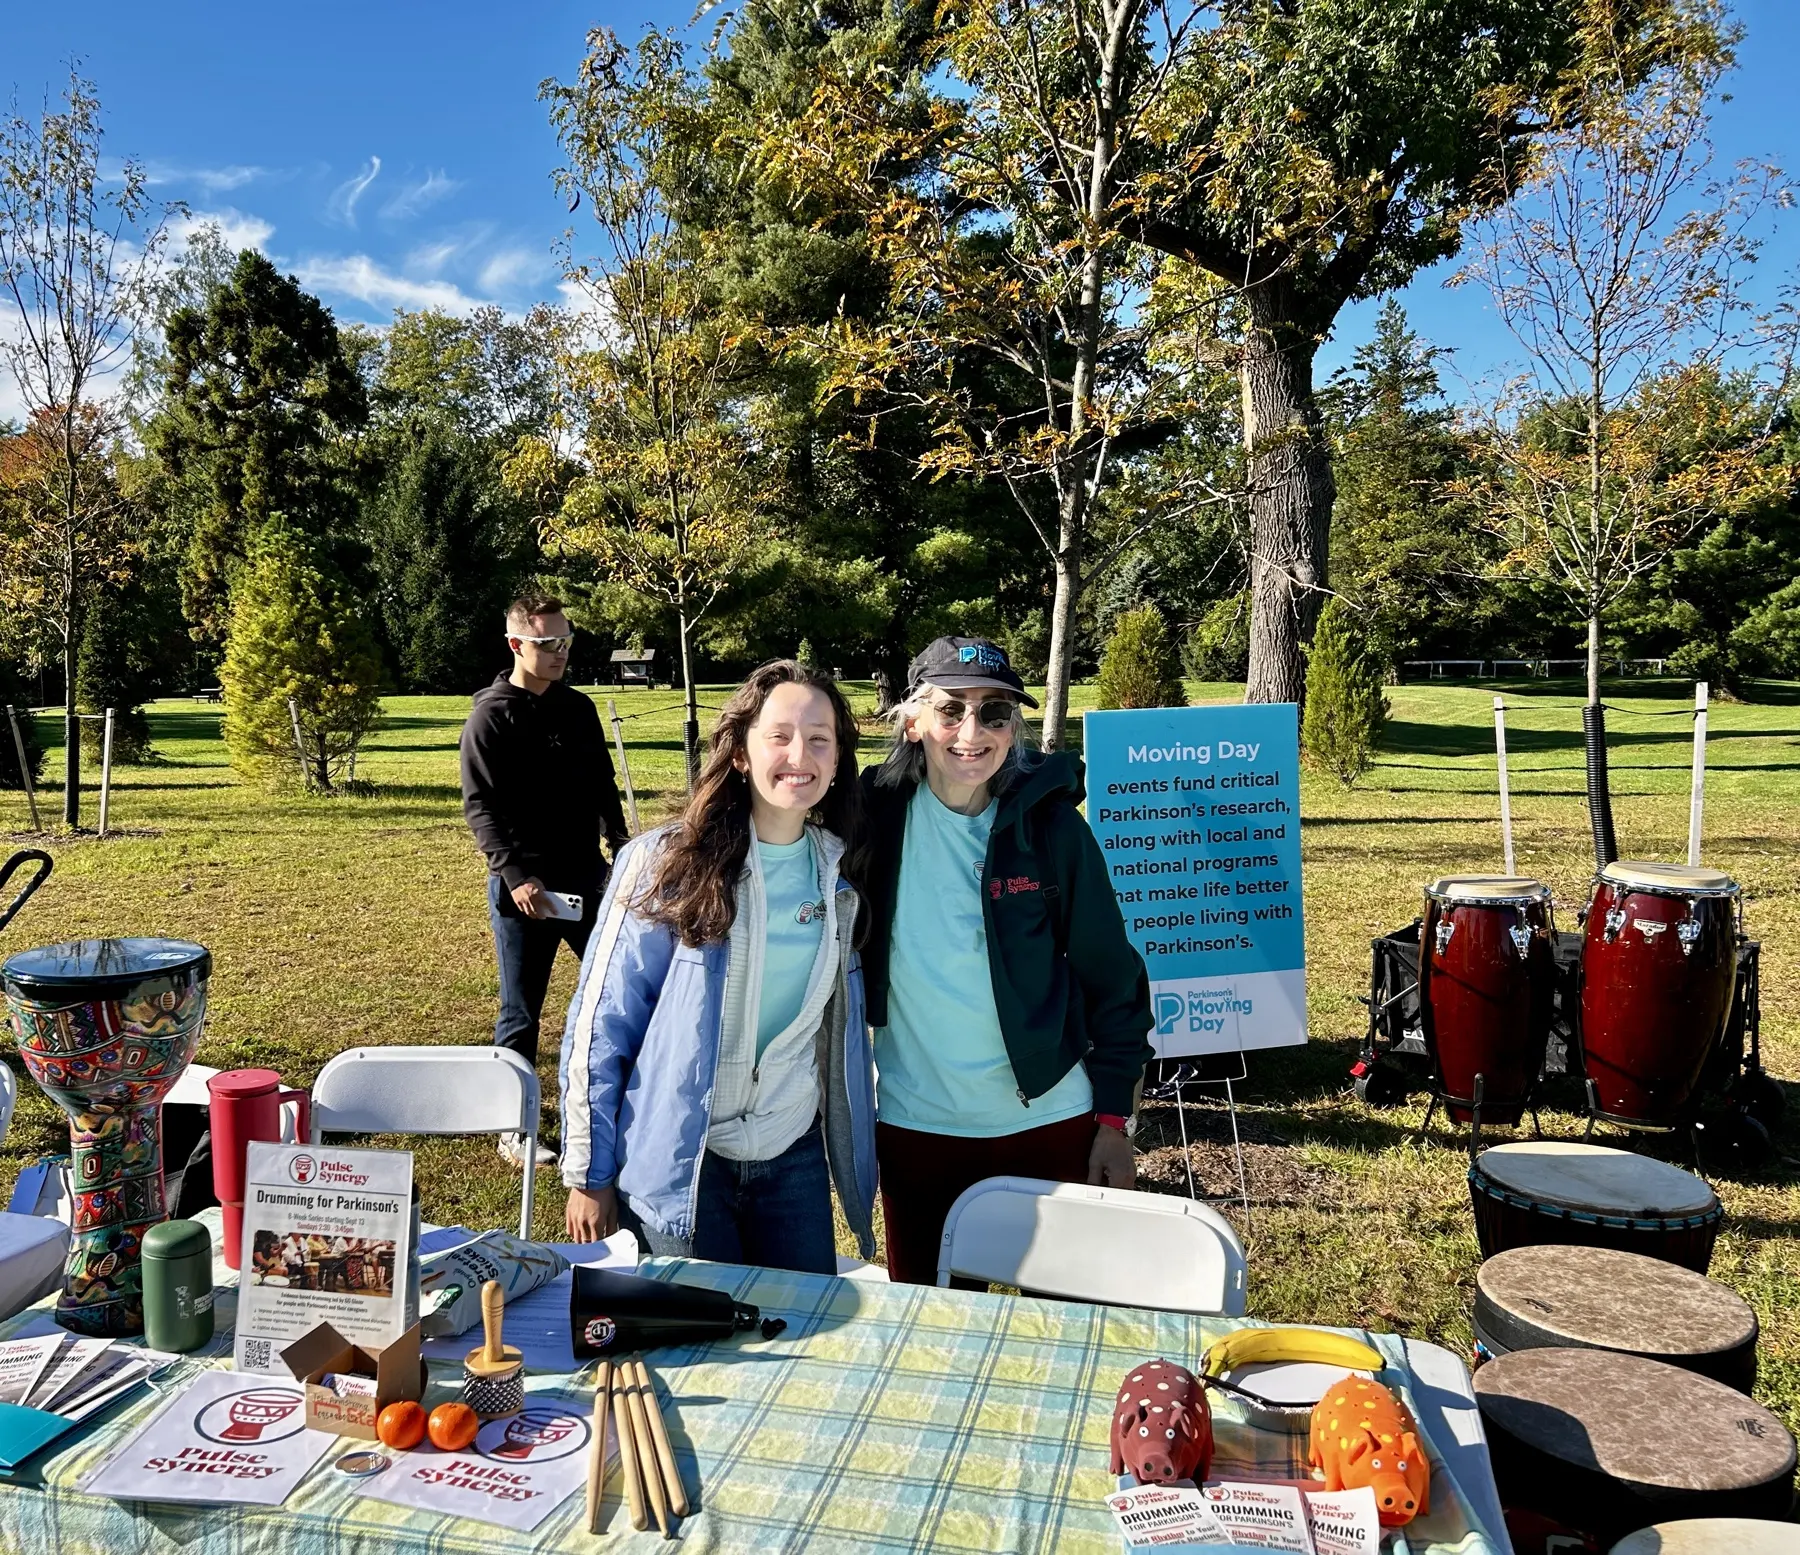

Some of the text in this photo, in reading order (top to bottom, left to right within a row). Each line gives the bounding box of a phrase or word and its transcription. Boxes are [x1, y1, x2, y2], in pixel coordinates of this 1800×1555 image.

[1128, 741, 1260, 764] Moving Day
[1107, 771, 1280, 795] events fund critical
[1100, 798, 1291, 823] Parkinson's research,
[1104, 824, 1286, 851] along with local and
[1113, 854, 1279, 877] national programs
[1007, 876, 1029, 886] Pulse
[1007, 881, 1040, 895] Synergy
[1114, 880, 1289, 904] hat make life better
[1133, 911, 1196, 932] people
[1200, 908, 1249, 925] living
[1253, 904, 1293, 921] with
[1145, 934, 1254, 956] Parkinson's.
[1187, 987, 1233, 1000] Parkinson's
[1188, 996, 1253, 1016] Moving
[1189, 1016, 1225, 1034] Day
[320, 1161, 354, 1172] Pulse
[319, 1170, 370, 1186] Synergy
[257, 1190, 399, 1214] Drumming for Parkinson's
[464, 1247, 499, 1278] Sticks
[345, 1381, 366, 1390] Pulse
[175, 1447, 268, 1464] Pulse
[143, 1457, 285, 1480] Synergy
[443, 1460, 532, 1485] Pulse
[411, 1467, 544, 1502] Synergy
[1232, 1489, 1264, 1497] Pulse
[1134, 1490, 1164, 1500] Pulse
[1136, 1492, 1180, 1506] Synergy
[1233, 1494, 1281, 1504] Synergy
[1120, 1501, 1200, 1525] DRUMMING
[1128, 1512, 1202, 1532] FOR PARKINSON'S
[1211, 1504, 1294, 1520] DRUMMING
[1234, 1515, 1294, 1528] PARKINSON'S
[1133, 1537, 1150, 1546] Add
[1150, 1532, 1185, 1543] Rhythm
[1196, 1525, 1217, 1533] Your
[1231, 1529, 1267, 1541] Rhythm
[1280, 1535, 1301, 1545] Your
